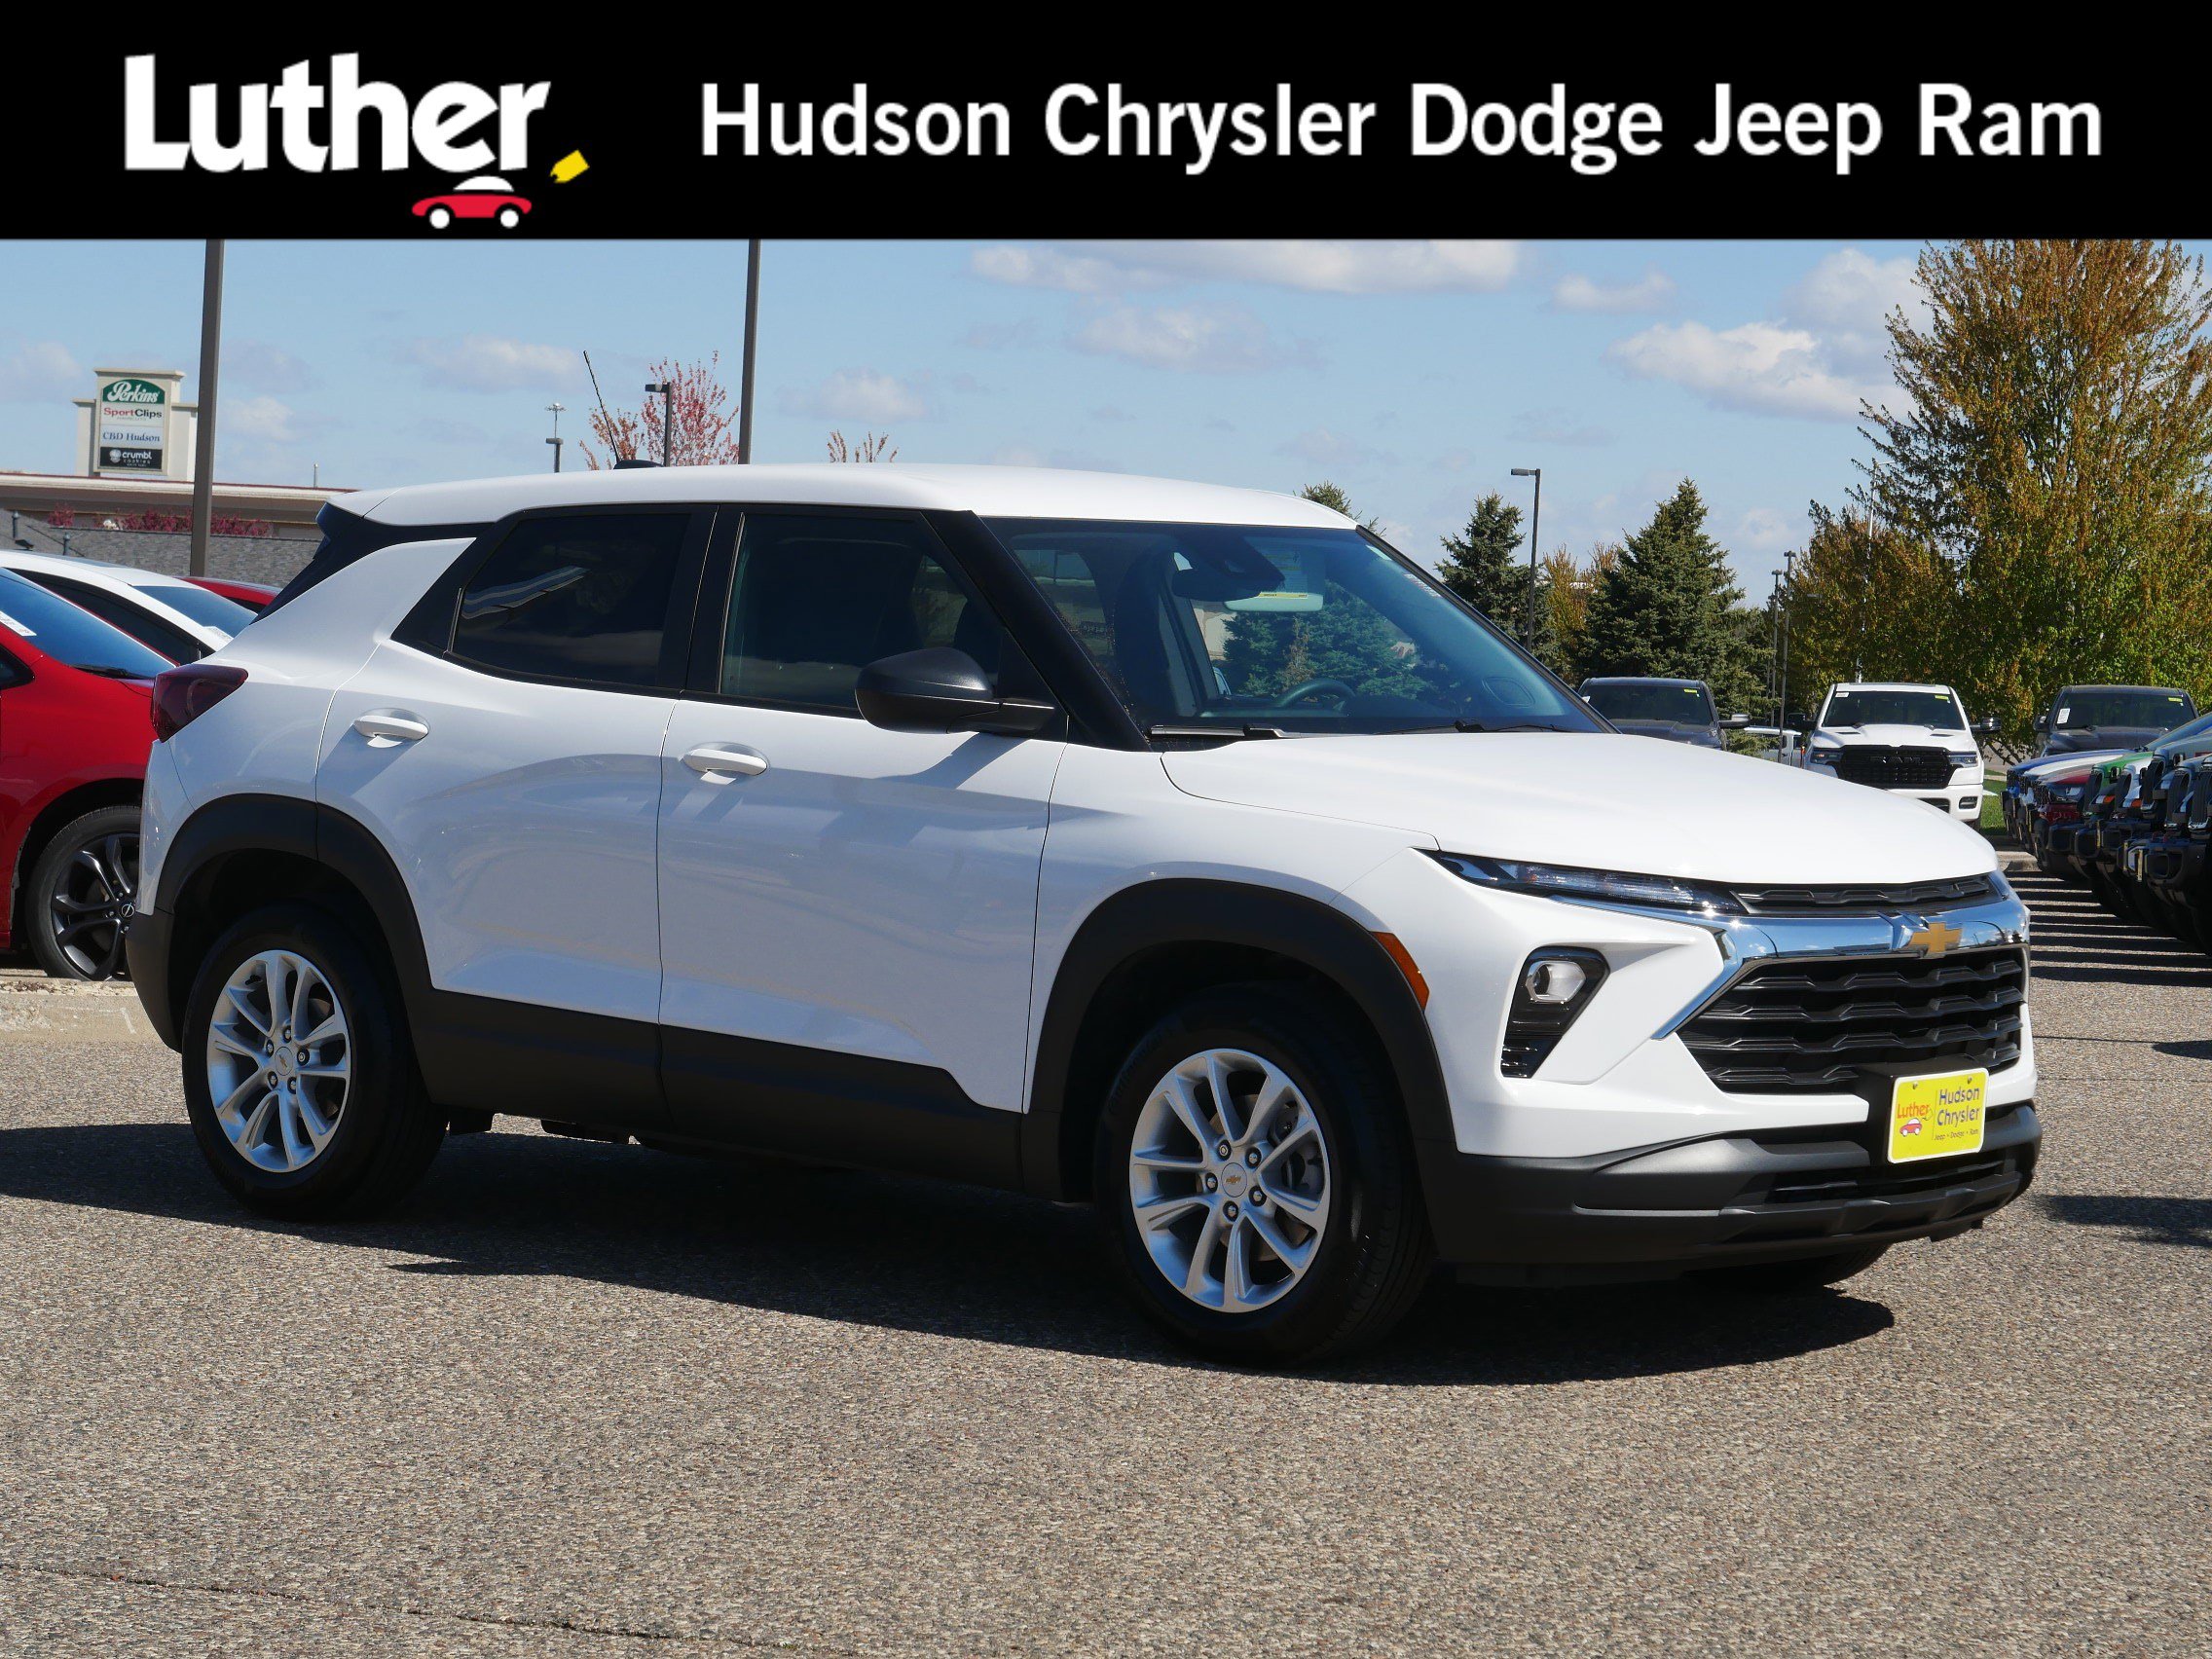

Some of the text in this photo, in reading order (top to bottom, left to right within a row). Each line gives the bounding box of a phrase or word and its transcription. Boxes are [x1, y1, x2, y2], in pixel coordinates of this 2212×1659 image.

[107, 381, 159, 403] Perkins
[127, 432, 160, 442] Hudson
[122, 451, 152, 460] crumbl
[1938, 1087, 1979, 1105] Hudson
[1897, 1102, 1929, 1119] Luther
[1936, 1106, 1979, 1127] Chrysler
